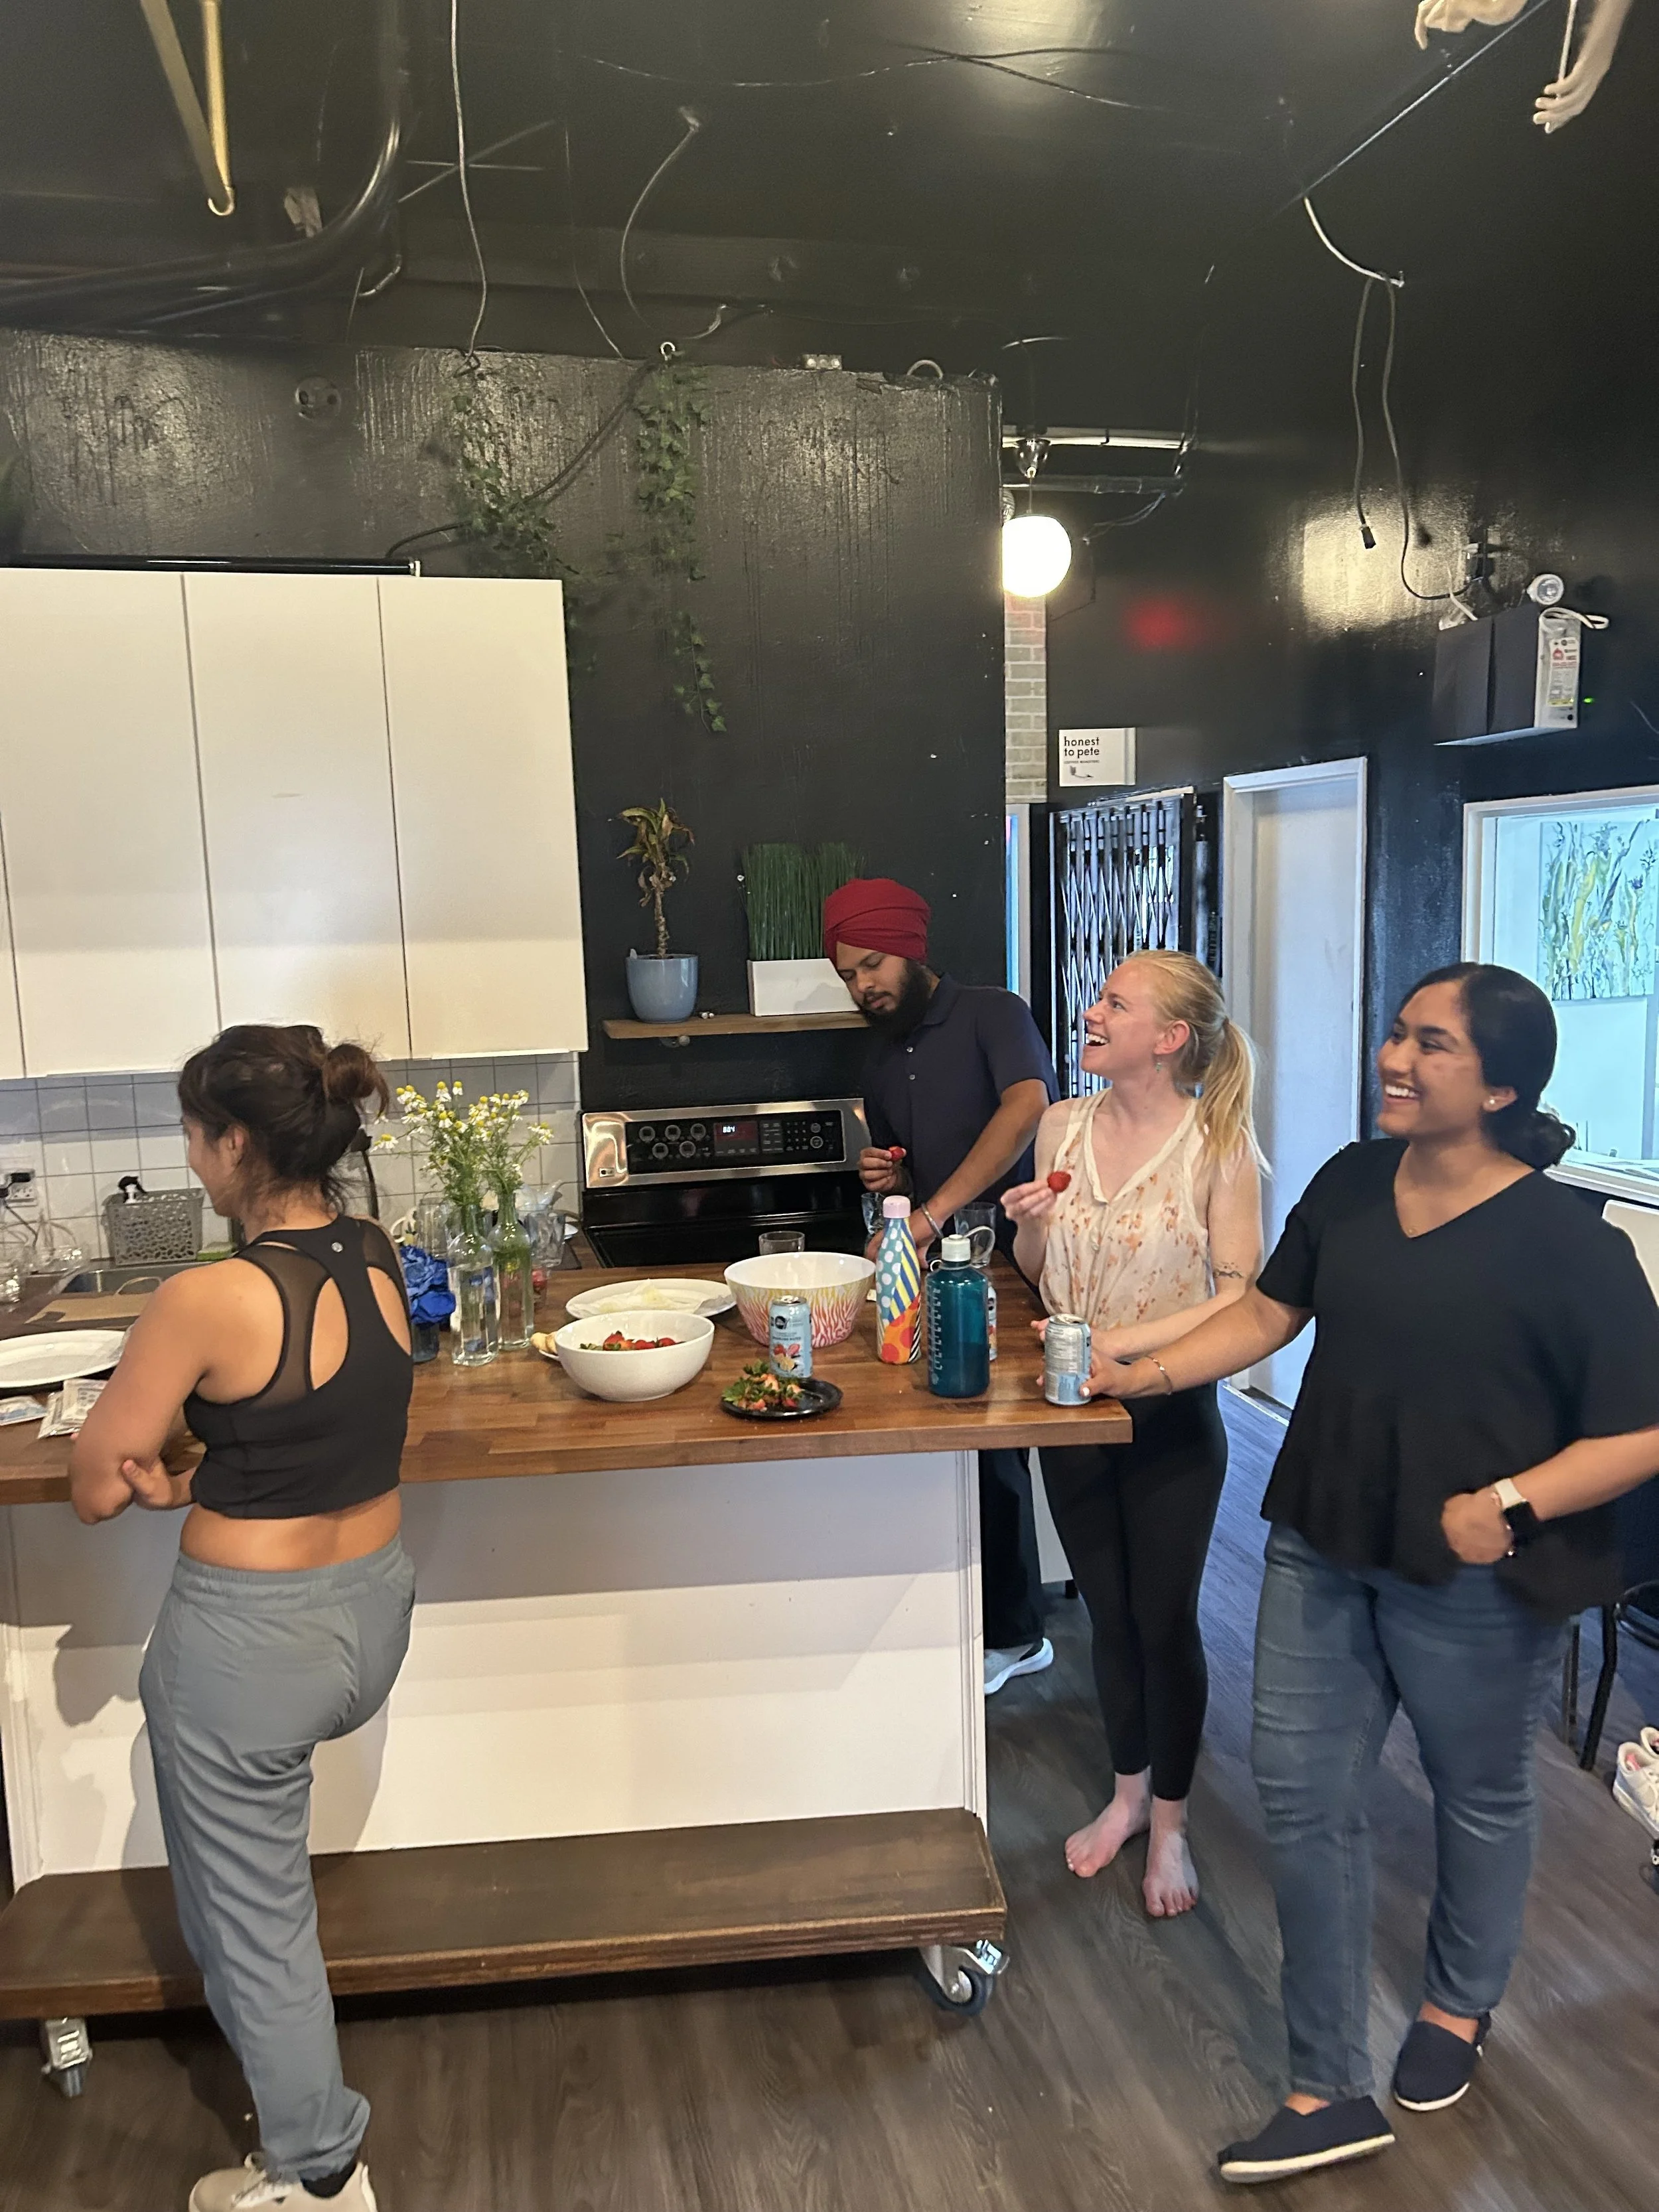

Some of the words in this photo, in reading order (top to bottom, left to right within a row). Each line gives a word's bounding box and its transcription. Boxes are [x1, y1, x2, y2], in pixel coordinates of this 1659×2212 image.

[1064, 736, 1100, 746] honest
[1064, 748, 1074, 757] to
[1077, 747, 1100, 759] pete
